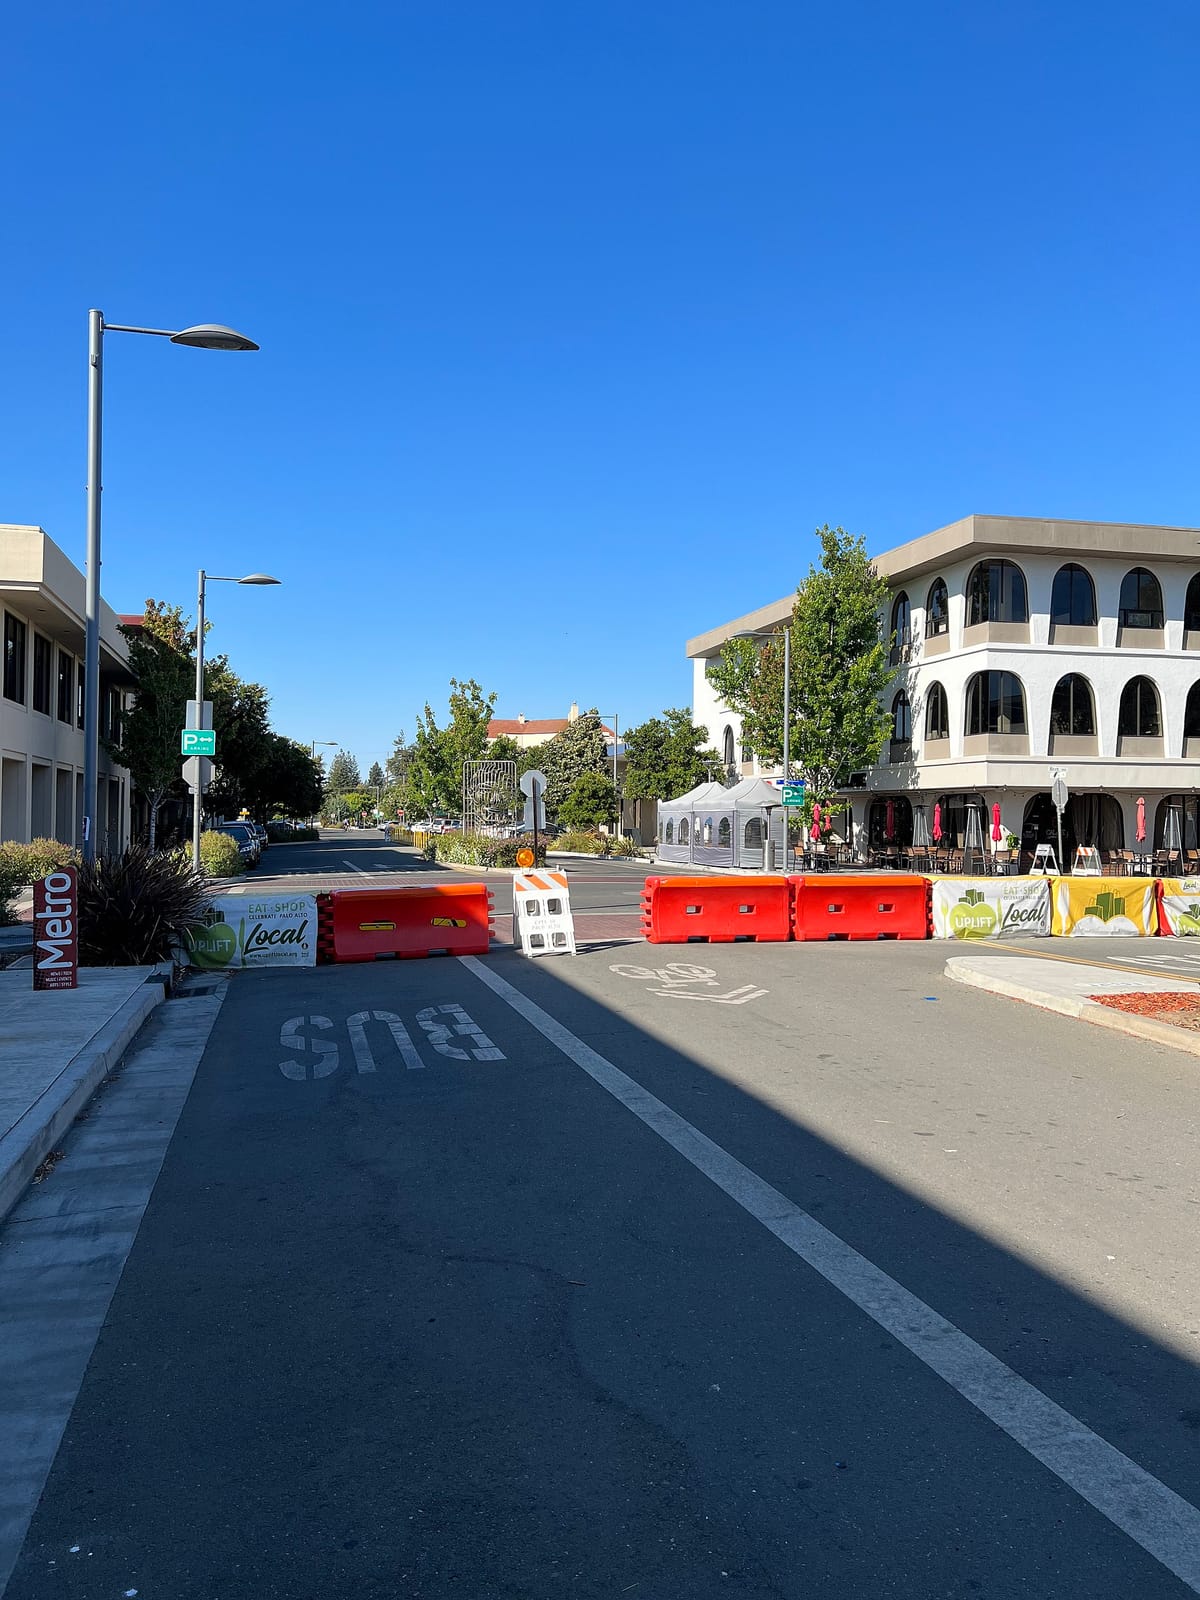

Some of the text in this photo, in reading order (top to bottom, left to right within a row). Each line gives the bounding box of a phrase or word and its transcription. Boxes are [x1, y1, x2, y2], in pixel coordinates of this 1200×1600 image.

[36, 872, 74, 970] Metro
[248, 902, 306, 913] EAT SHOP
[955, 916, 993, 928] UPLIFT
[1000, 901, 1046, 931] Local
[188, 939, 231, 952] UPLIFT
[243, 919, 309, 956] Local
[278, 1003, 508, 1081] BUS
